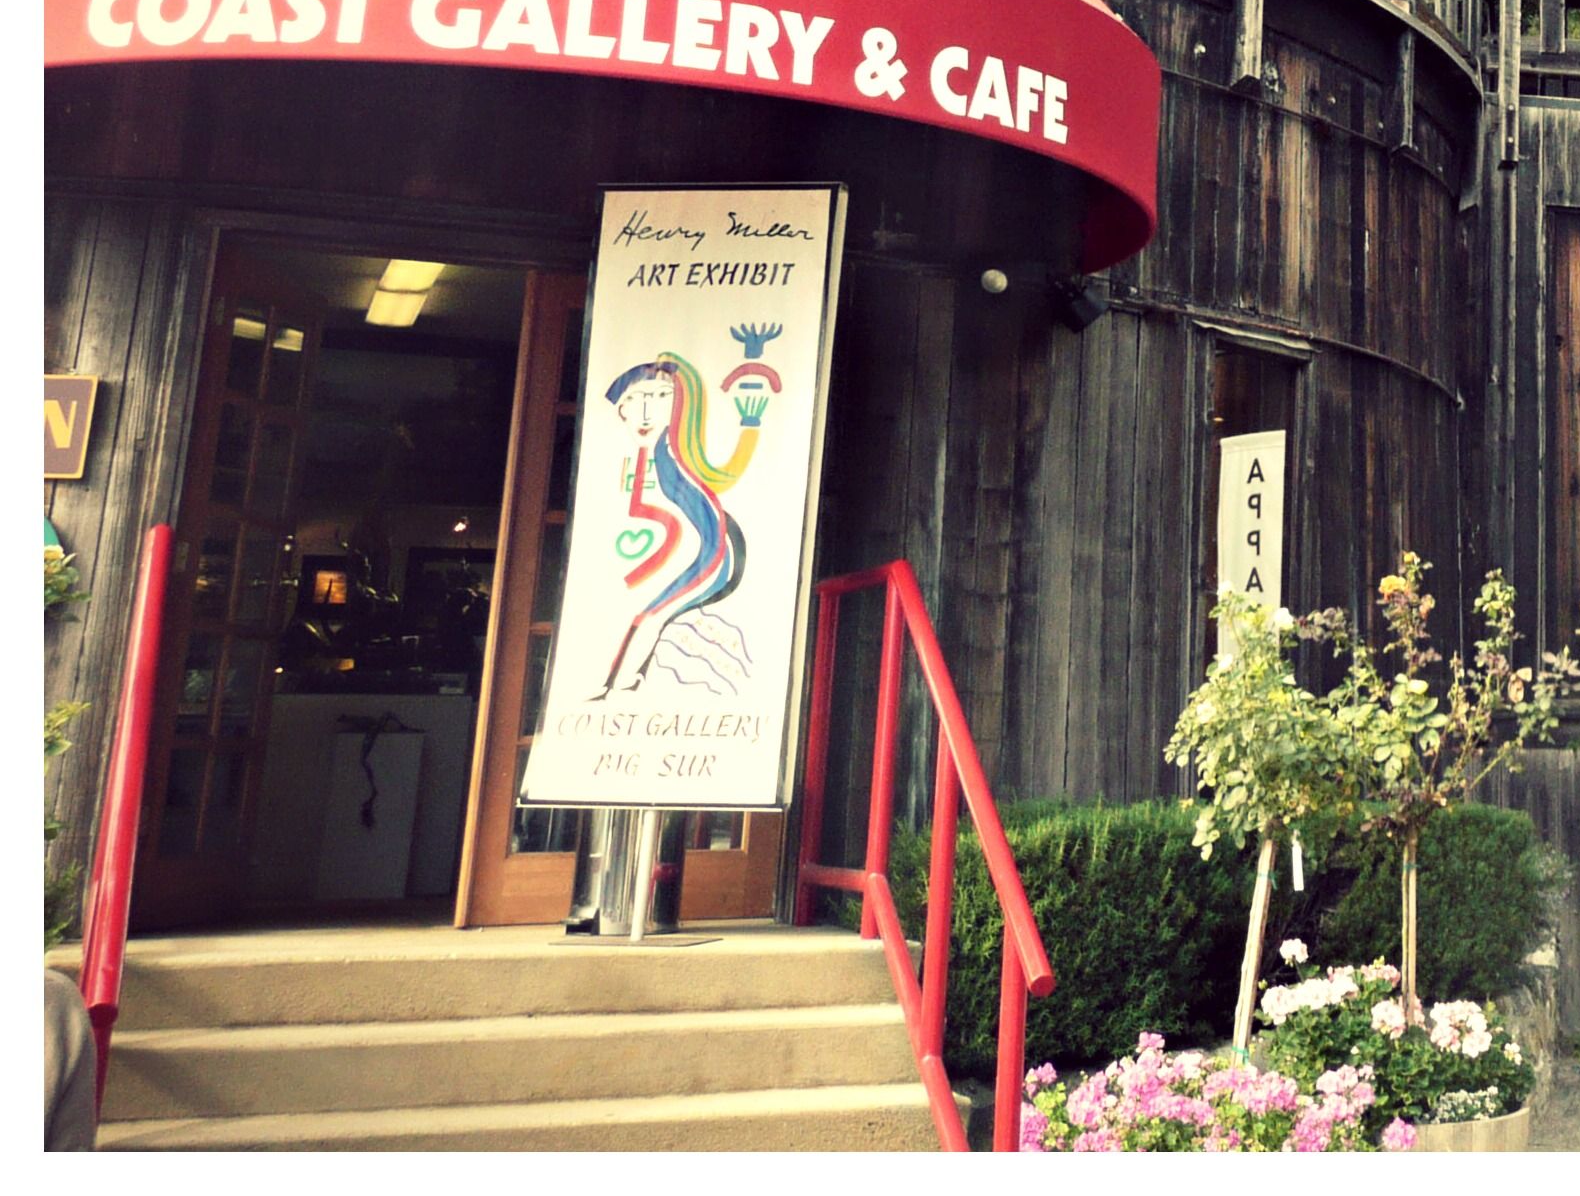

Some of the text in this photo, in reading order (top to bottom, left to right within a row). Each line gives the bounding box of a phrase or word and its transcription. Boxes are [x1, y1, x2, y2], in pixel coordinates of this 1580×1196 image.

[853, 26, 908, 103] &
[929, 45, 1070, 145] CAFE
[613, 209, 814, 251] Henry Miller
[627, 262, 795, 289] ART EXHIBIT
[646, 713, 769, 743] GALLERY
[593, 753, 717, 778] BIG SUR
